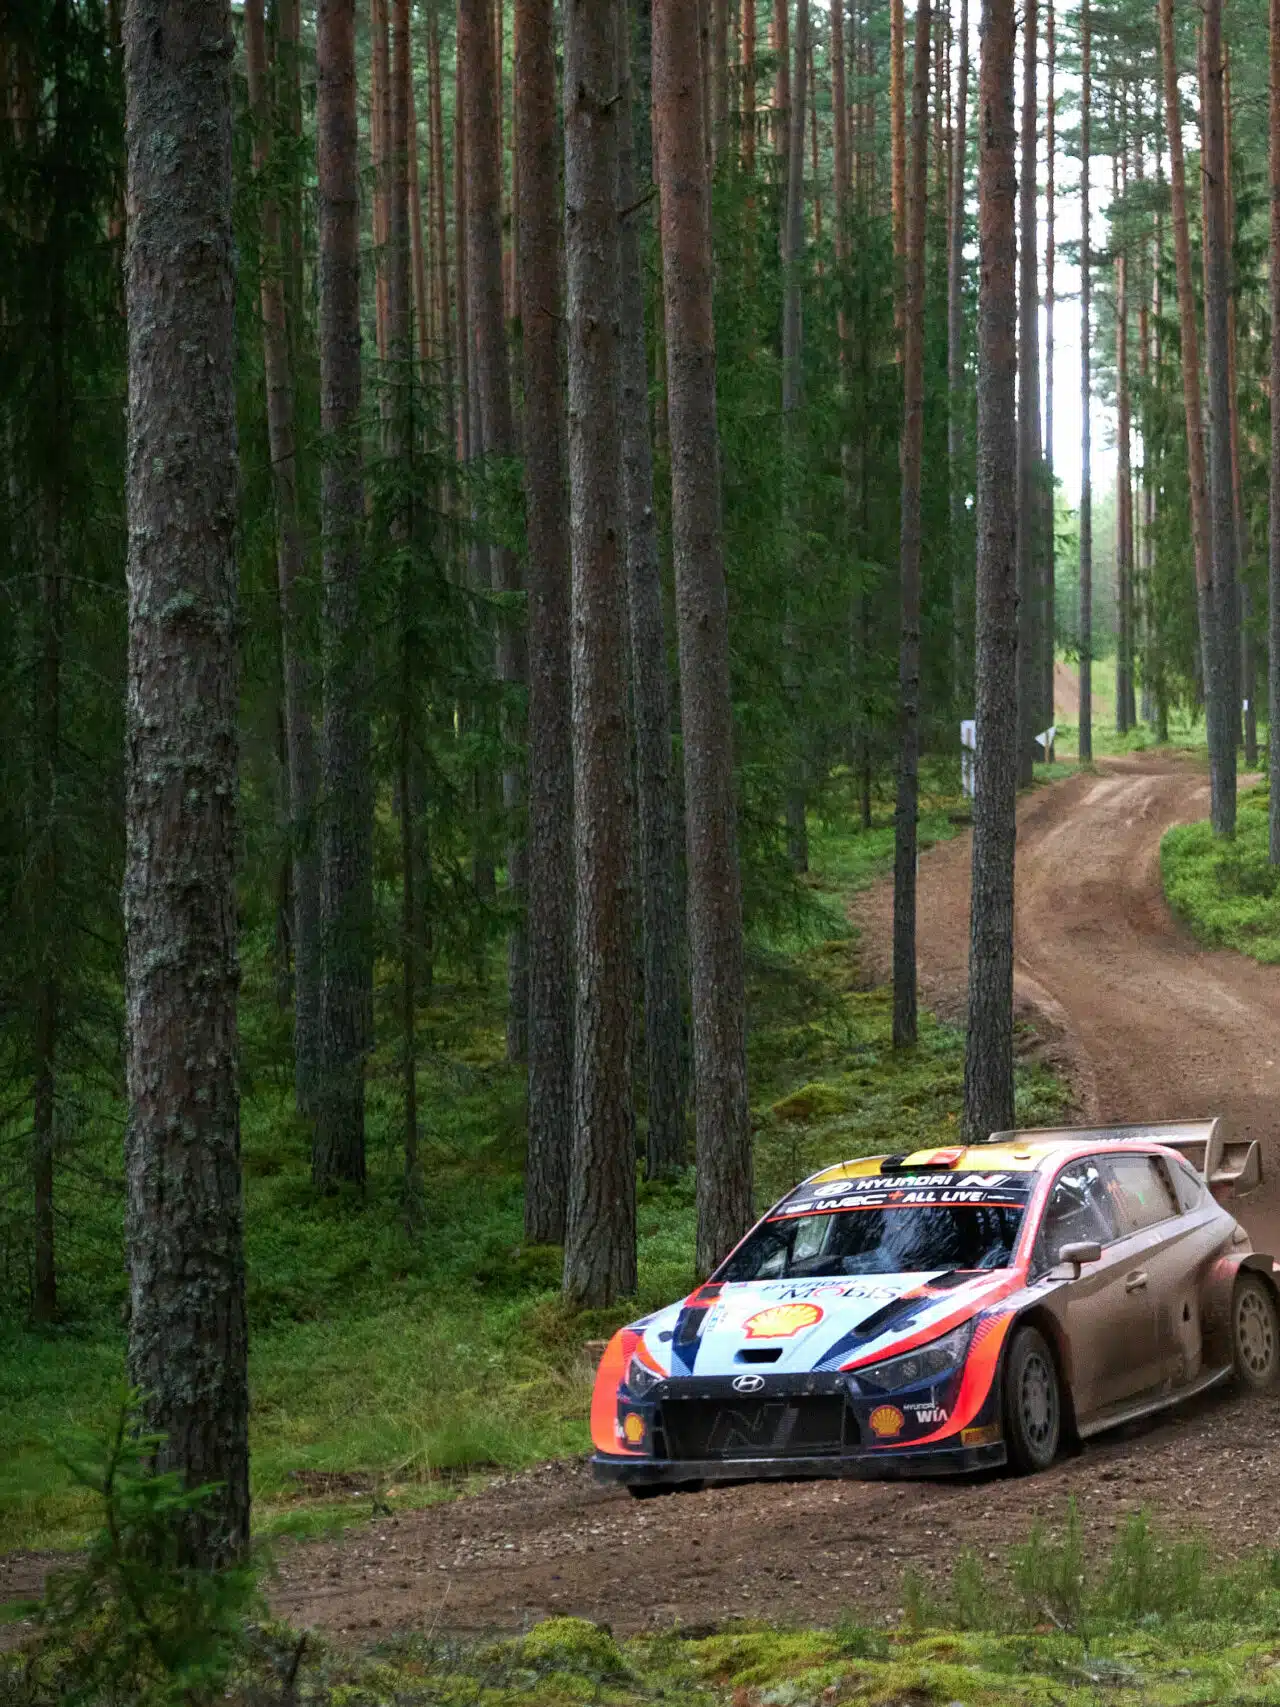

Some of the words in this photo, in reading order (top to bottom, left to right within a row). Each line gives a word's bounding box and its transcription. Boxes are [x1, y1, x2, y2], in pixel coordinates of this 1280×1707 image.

[856, 1175, 953, 1191] HYUNDAI
[902, 1191, 937, 1203] ALL
[940, 1190, 984, 1202] LIVE
[762, 1279, 858, 1292] HYUNDAI
[902, 1401, 936, 1411] HYUNDAI
[916, 1406, 949, 1423] WIA
